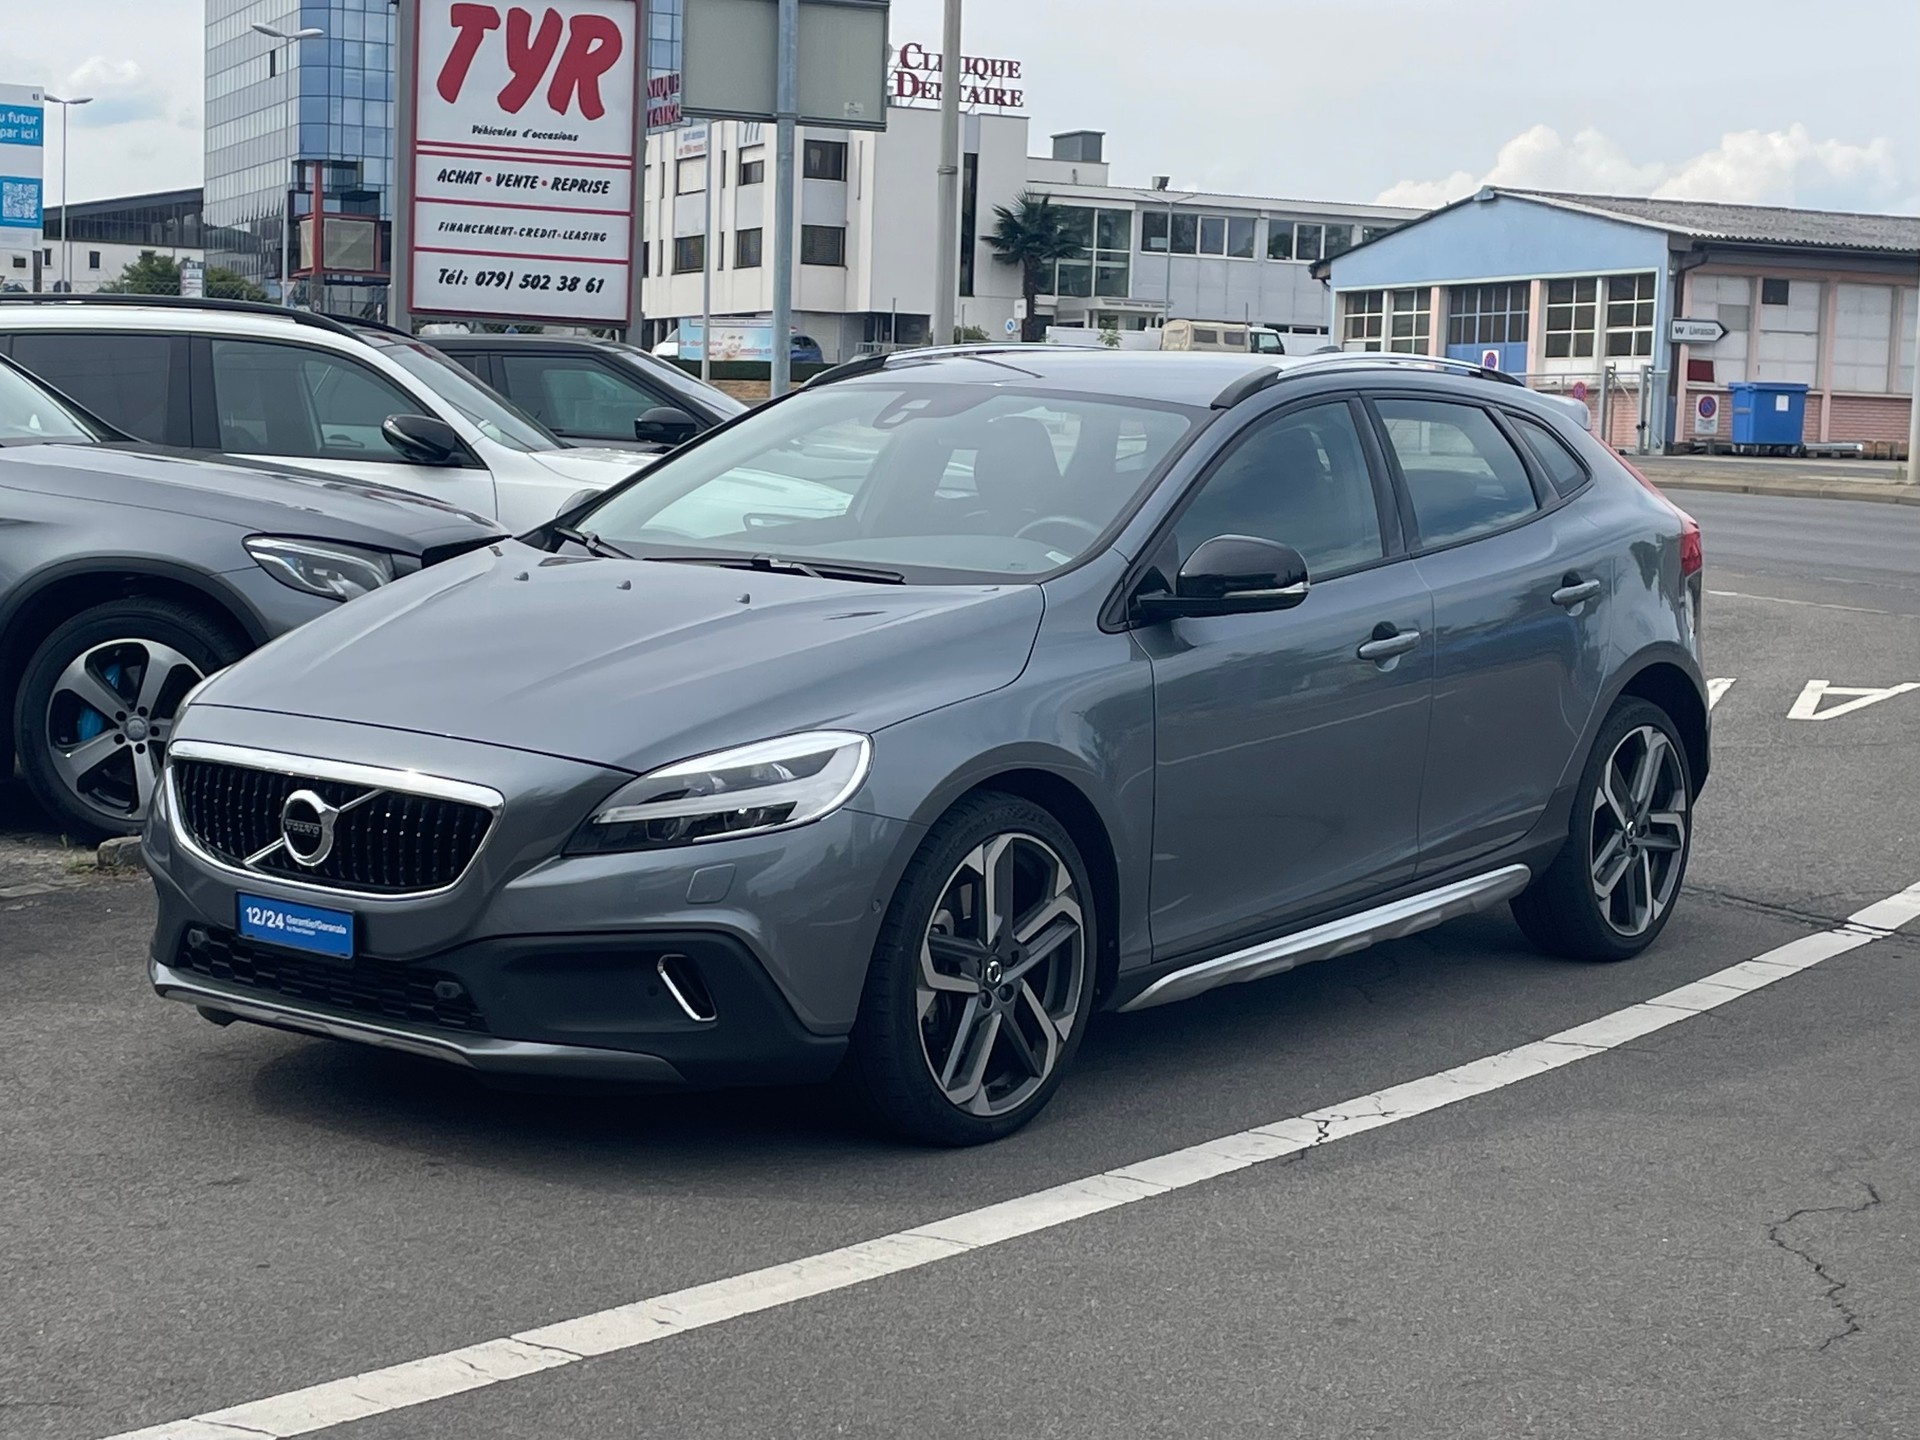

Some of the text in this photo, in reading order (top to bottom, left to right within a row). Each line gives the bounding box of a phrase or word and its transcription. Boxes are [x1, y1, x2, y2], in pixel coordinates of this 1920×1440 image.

[436, 3, 623, 121] TYR
[900, 42, 1021, 80] CLIIQUE
[894, 70, 1023, 107] DEAIRE
[8, 111, 39, 125] futur
[0, 127, 18, 139] par
[471, 124, 579, 142] Véhicules d'occasions
[437, 168, 611, 195] ACHAT VENTE REPRISE
[438, 268, 469, 286] Tél:
[518, 274, 551, 291] 502
[556, 276, 581, 292] 38
[585, 277, 604, 294] 61
[285, 820, 320, 836] VOLVO
[246, 906, 285, 930] 12/24
